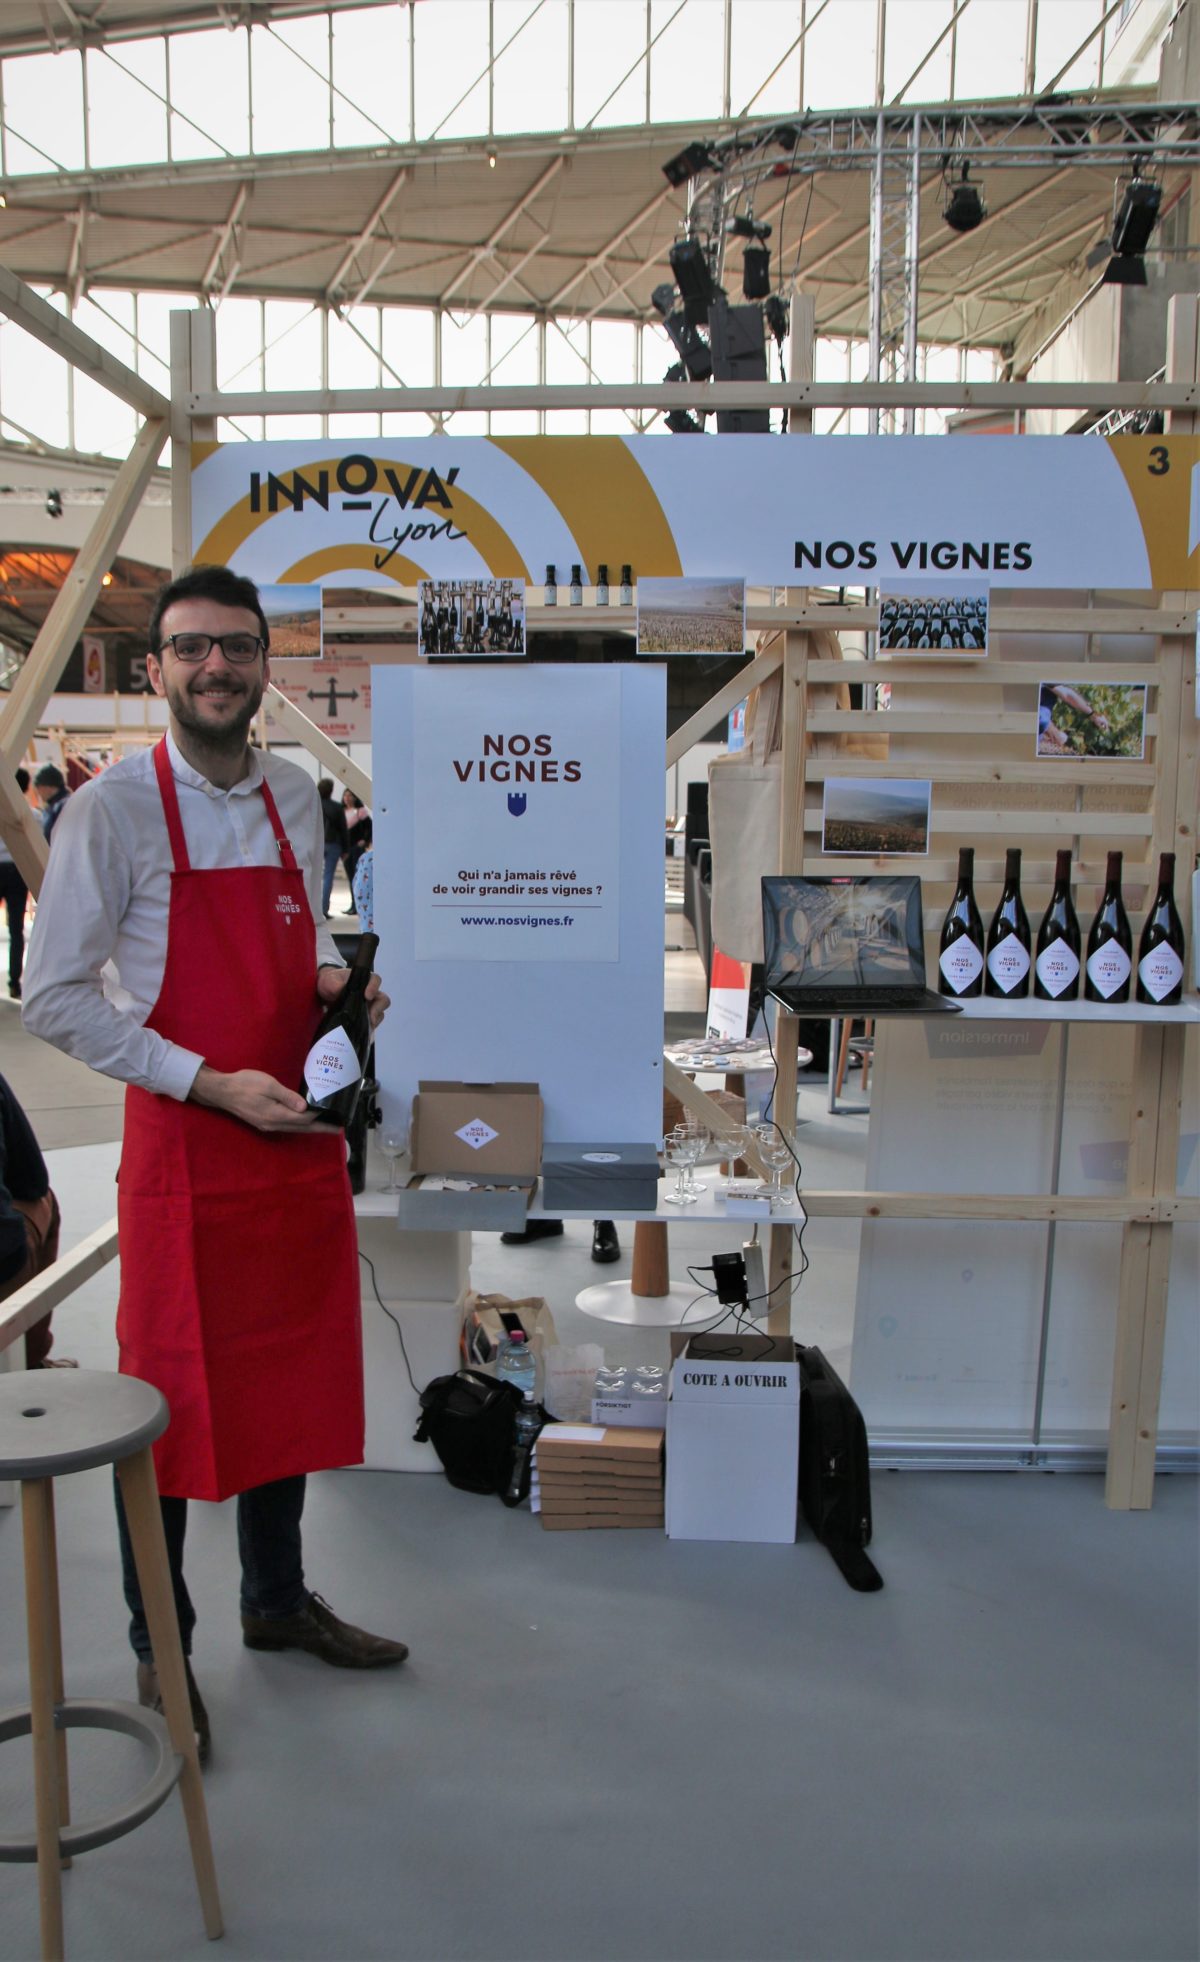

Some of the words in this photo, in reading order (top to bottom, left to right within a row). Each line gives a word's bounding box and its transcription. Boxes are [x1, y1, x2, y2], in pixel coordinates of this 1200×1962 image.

[1147, 446, 1171, 475] 3
[368, 497, 468, 570] Lyon
[794, 541, 878, 570] NOS
[890, 541, 1033, 571] VIGNES
[483, 734, 553, 756] NOS
[452, 760, 582, 783] VIGNES
[457, 869, 479, 882] Qui
[504, 870, 546, 882] jamais
[550, 869, 577, 881] rêvé
[432, 884, 449, 895] de
[451, 884, 476, 895] voir
[478, 884, 525, 897] grandir
[528, 887, 549, 896] ses
[551, 885, 593, 897] vignes
[596, 886, 602, 895] ?
[278, 895, 292, 904] NOS
[275, 904, 300, 913] VIGNES
[460, 915, 574, 927] www.nosvignes.fr
[316, 1059, 344, 1070] VIGNES
[322, 1054, 340, 1063] NOS
[683, 1373, 717, 1386] COTE
[721, 1375, 730, 1386] A
[735, 1375, 787, 1387] OUVRIR
